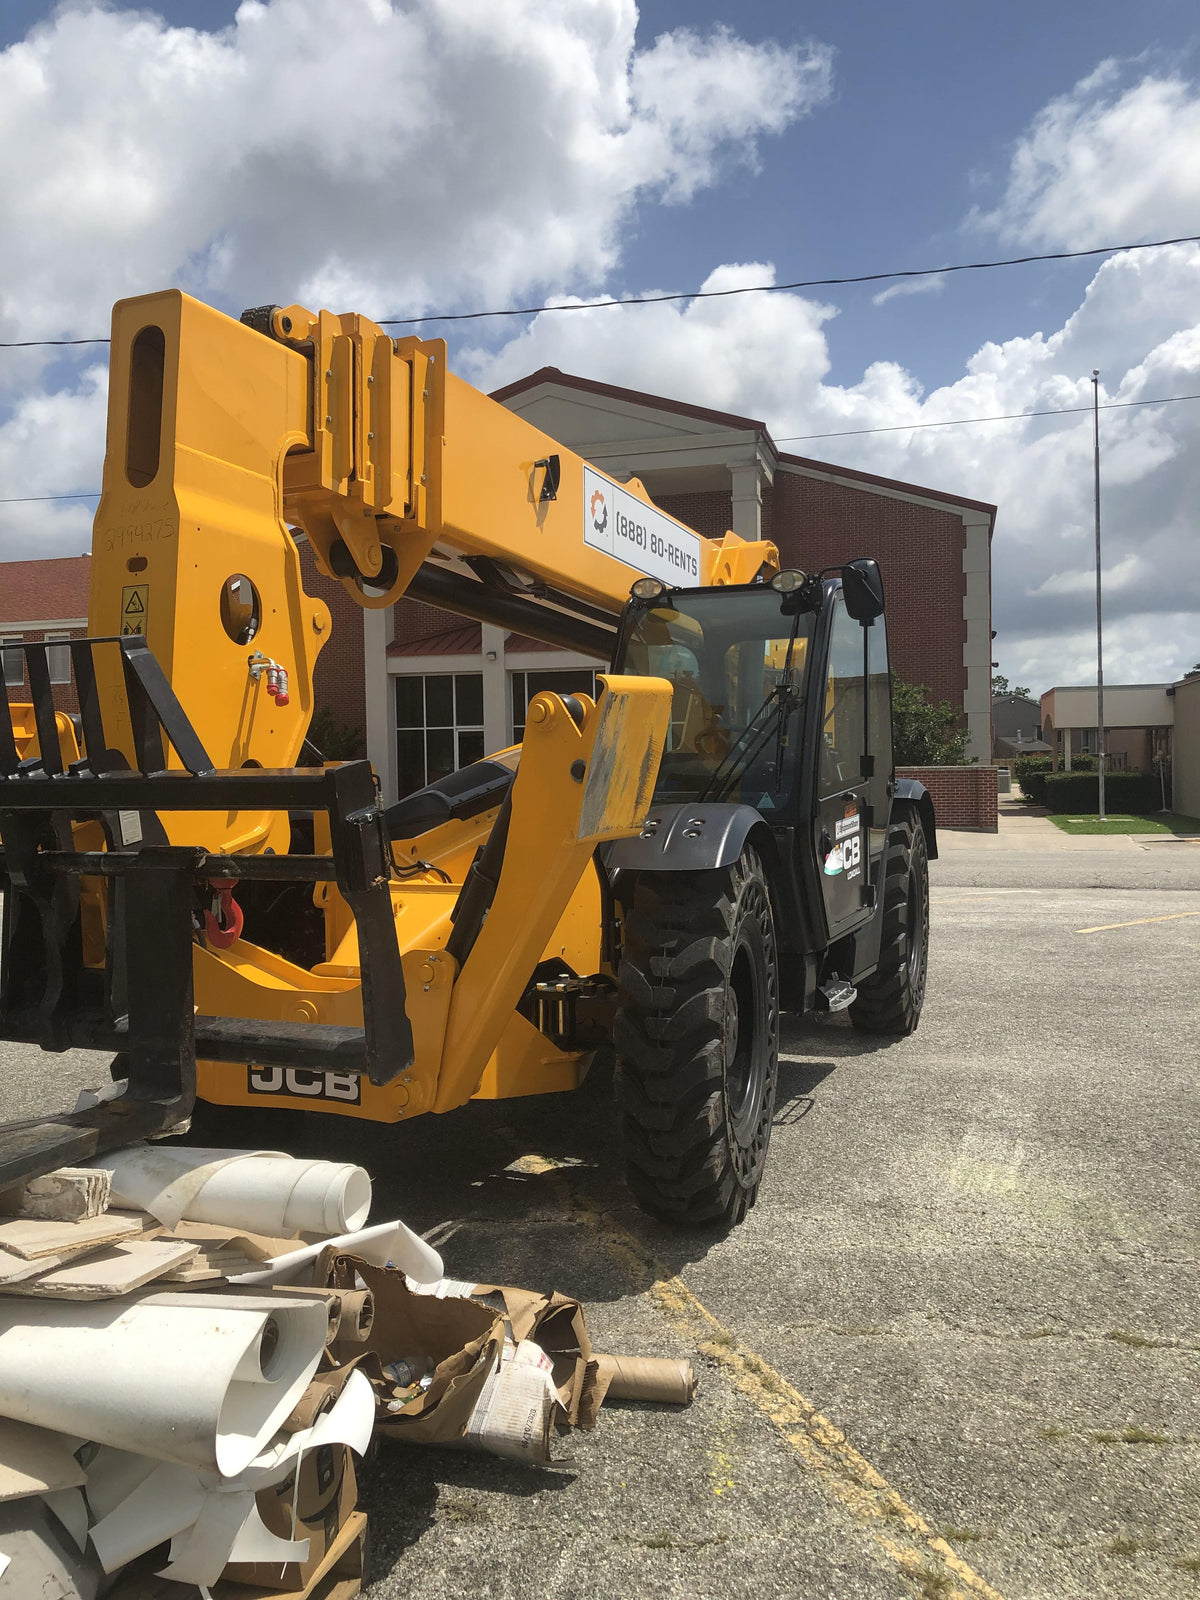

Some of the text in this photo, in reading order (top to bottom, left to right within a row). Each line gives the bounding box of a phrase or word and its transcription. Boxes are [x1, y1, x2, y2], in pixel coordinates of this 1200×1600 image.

[616, 511, 698, 577] (888) 80-RENTS
[839, 835, 860, 870] CB
[251, 1067, 359, 1100] JCB
